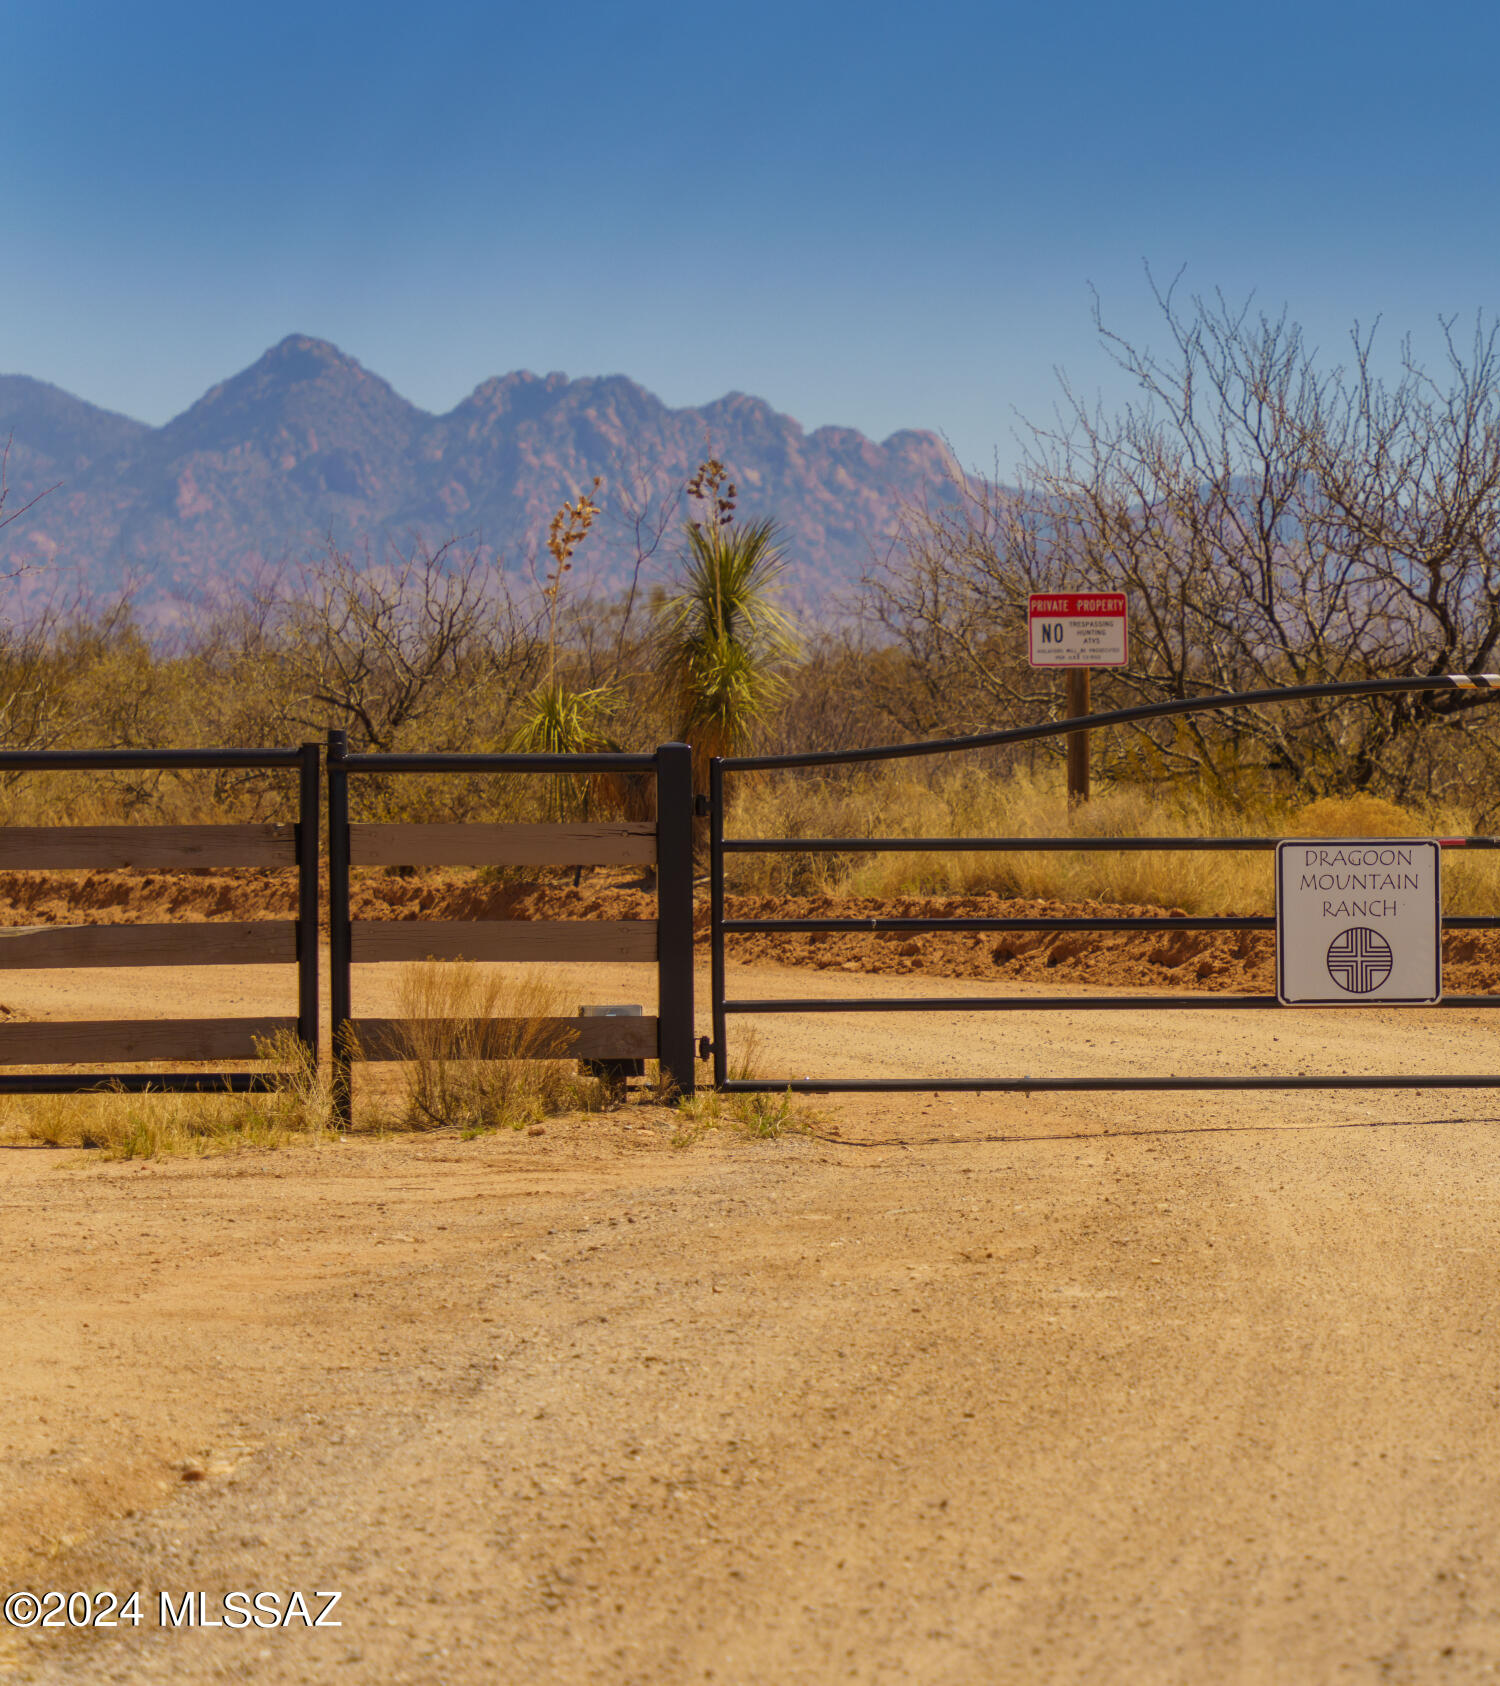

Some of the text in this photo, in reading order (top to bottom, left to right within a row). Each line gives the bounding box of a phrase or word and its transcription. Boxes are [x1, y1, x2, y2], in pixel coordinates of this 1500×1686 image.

[1031, 599, 1125, 612] PRIVATE PROPERTY
[1042, 623, 1063, 643] NO
[1305, 849, 1412, 867] DRAGOON
[1300, 873, 1418, 891] MOUNTAIN
[1322, 900, 1397, 917] RANCH
